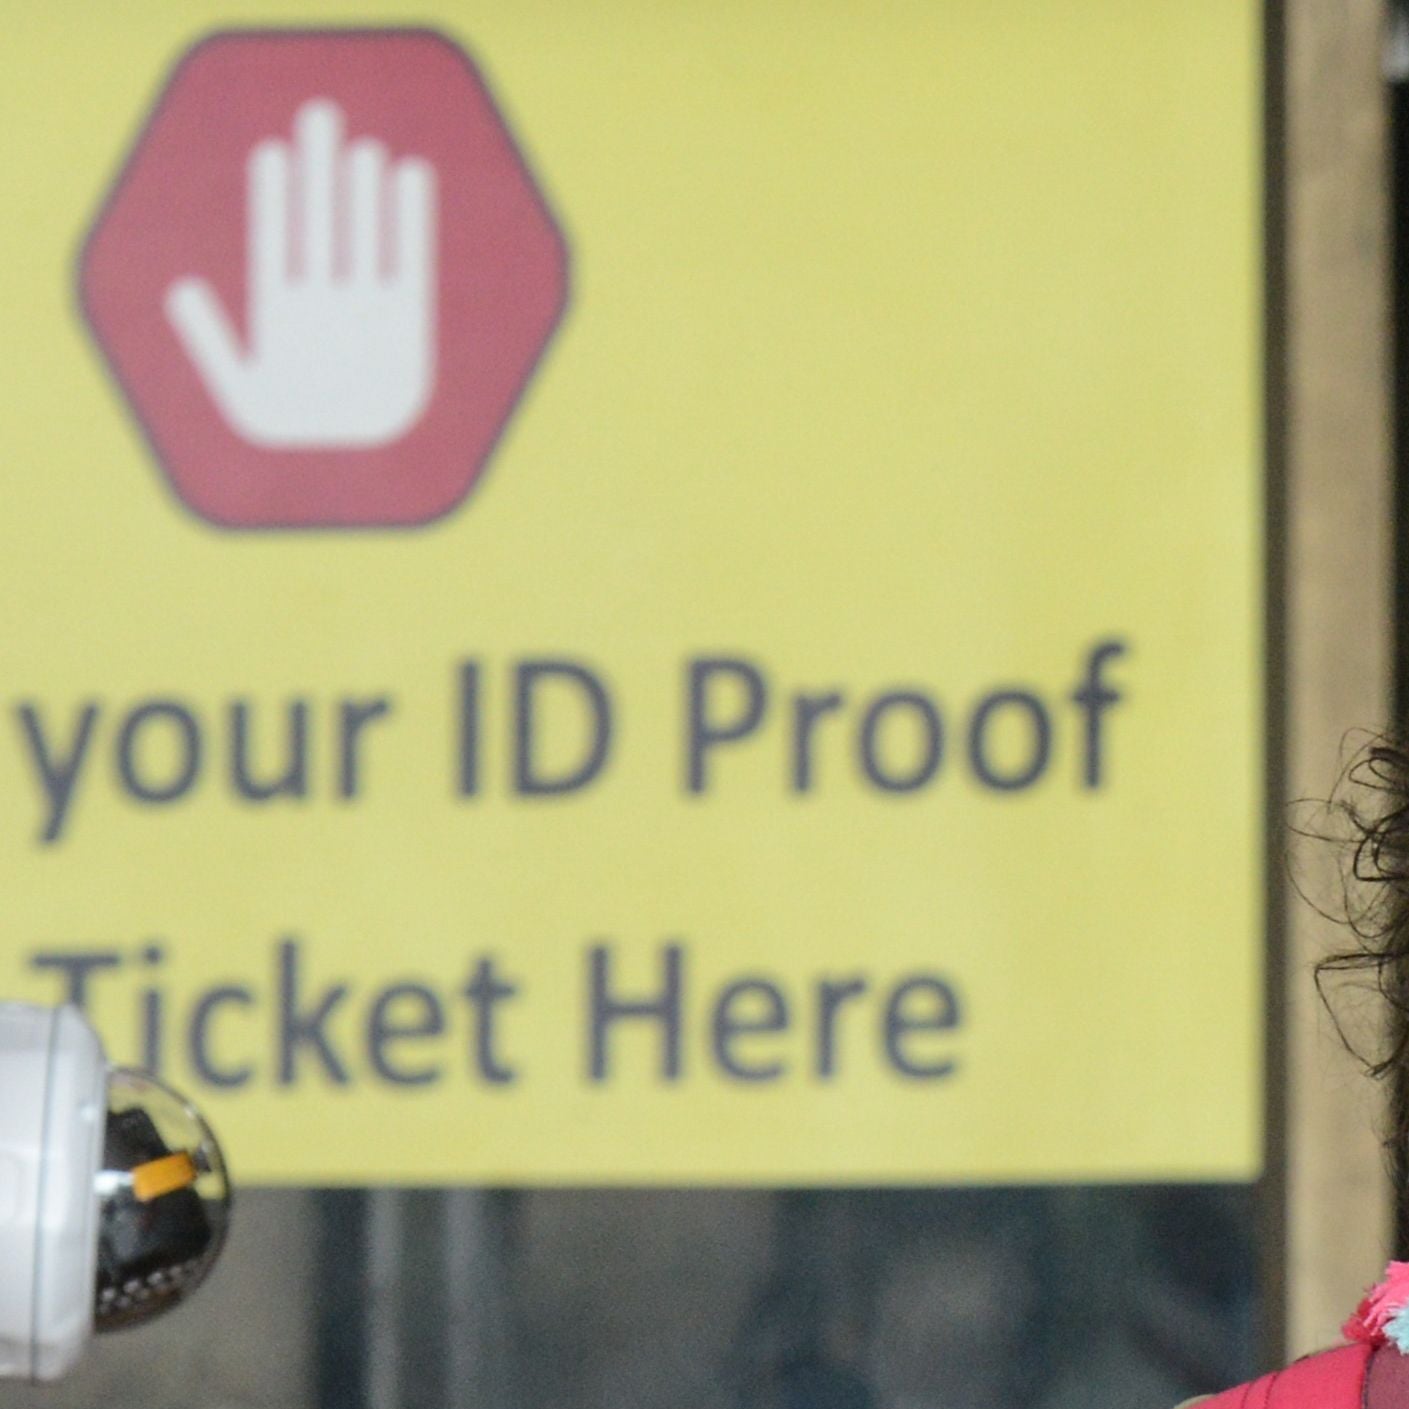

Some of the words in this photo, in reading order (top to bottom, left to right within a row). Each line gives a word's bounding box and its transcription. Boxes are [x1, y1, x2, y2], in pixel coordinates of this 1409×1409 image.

[12, 695, 394, 848] your
[453, 655, 618, 803] ID
[681, 635, 1132, 799] Proof
[28, 936, 519, 1088] Ticket
[584, 940, 965, 1086] Here
